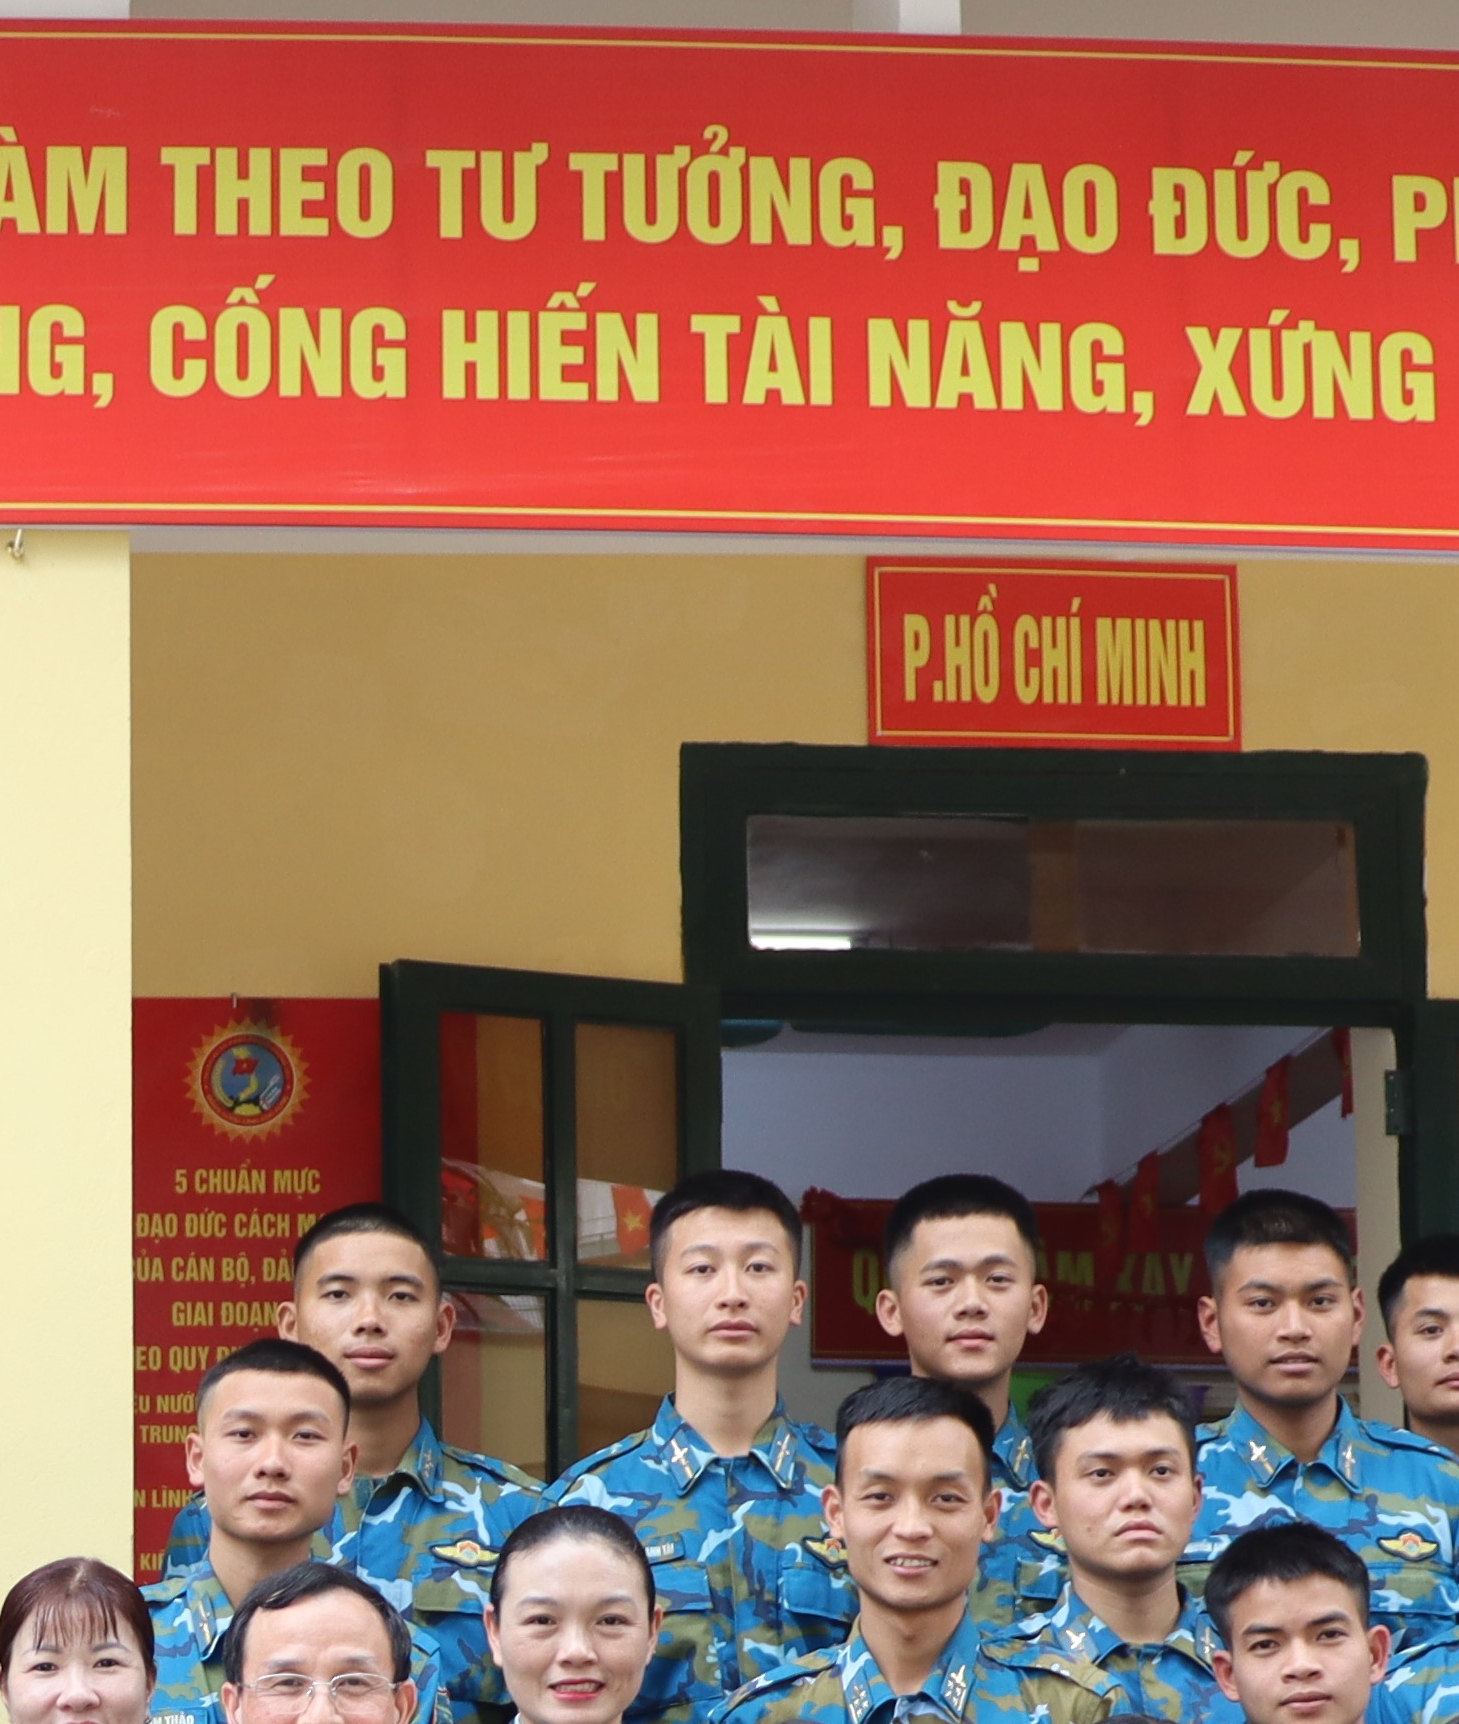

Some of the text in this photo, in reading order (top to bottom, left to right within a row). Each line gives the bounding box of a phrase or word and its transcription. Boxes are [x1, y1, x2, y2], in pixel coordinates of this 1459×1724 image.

[160, 146, 395, 238] THEO
[425, 141, 550, 241] TƯ
[568, 123, 905, 259] TƯỞNG,
[933, 160, 1120, 272] ĐẠO
[1148, 149, 1362, 272] ĐỨC,
[149, 273, 408, 399] CỐNG
[442, 281, 661, 402] HIẾN
[690, 294, 834, 406] TÀI
[867, 299, 1155, 426] NĂNG,
[1186, 308, 1437, 422] XỨNG
[903, 583, 1207, 706] P.HỒ CHÍ MINH
[175, 1159, 321, 1200] 5 CHUẨN MỰC
[136, 1208, 290, 1244] ĐẠO ĐỨC CÁCH
[171, 1251, 256, 1288] CÁN BỘ,
[172, 1301, 213, 1326] GIAI
[169, 1346, 209, 1374] QUY
